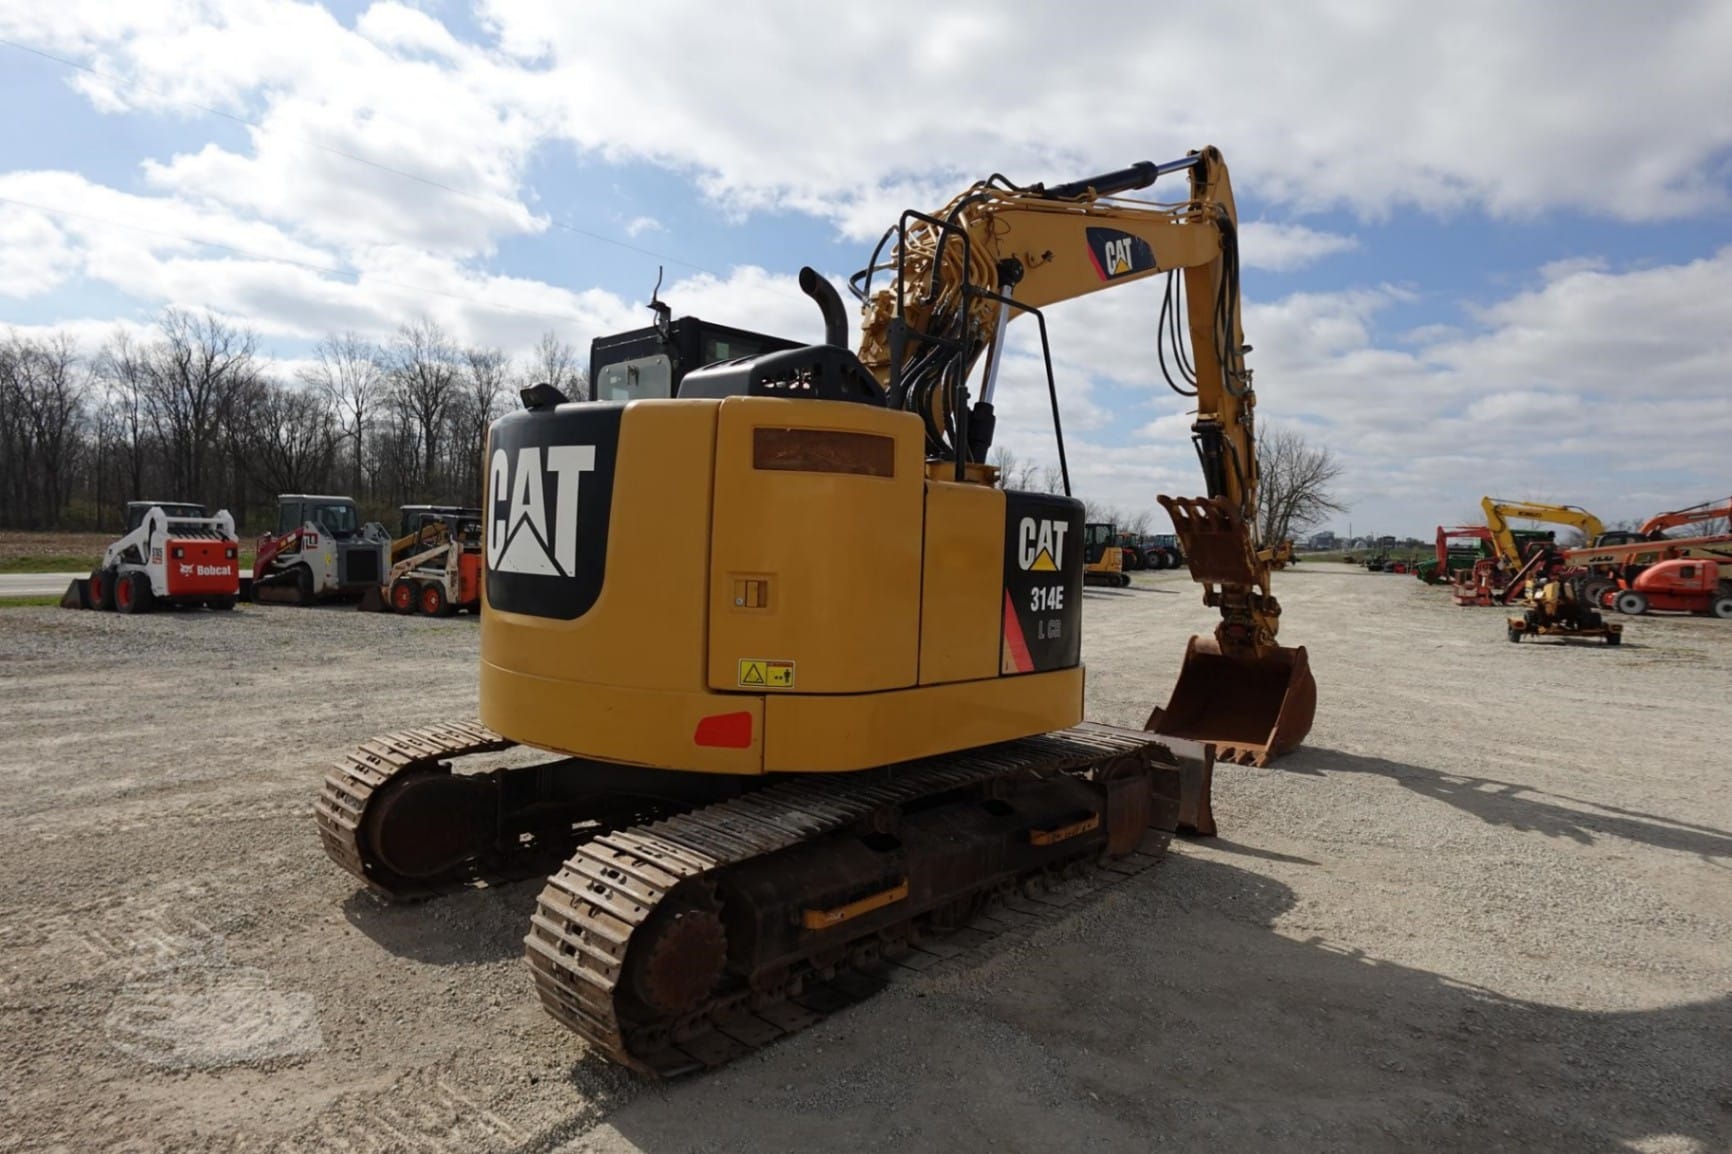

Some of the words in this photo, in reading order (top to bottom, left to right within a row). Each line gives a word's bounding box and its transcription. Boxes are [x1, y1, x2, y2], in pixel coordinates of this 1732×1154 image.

[1105, 237, 1133, 275] CAT
[487, 445, 596, 577] CAT
[1018, 517, 1069, 571] CAT
[197, 565, 231, 576] Bobcat
[1030, 586, 1064, 612] 314E
[1038, 620, 1046, 640] L
